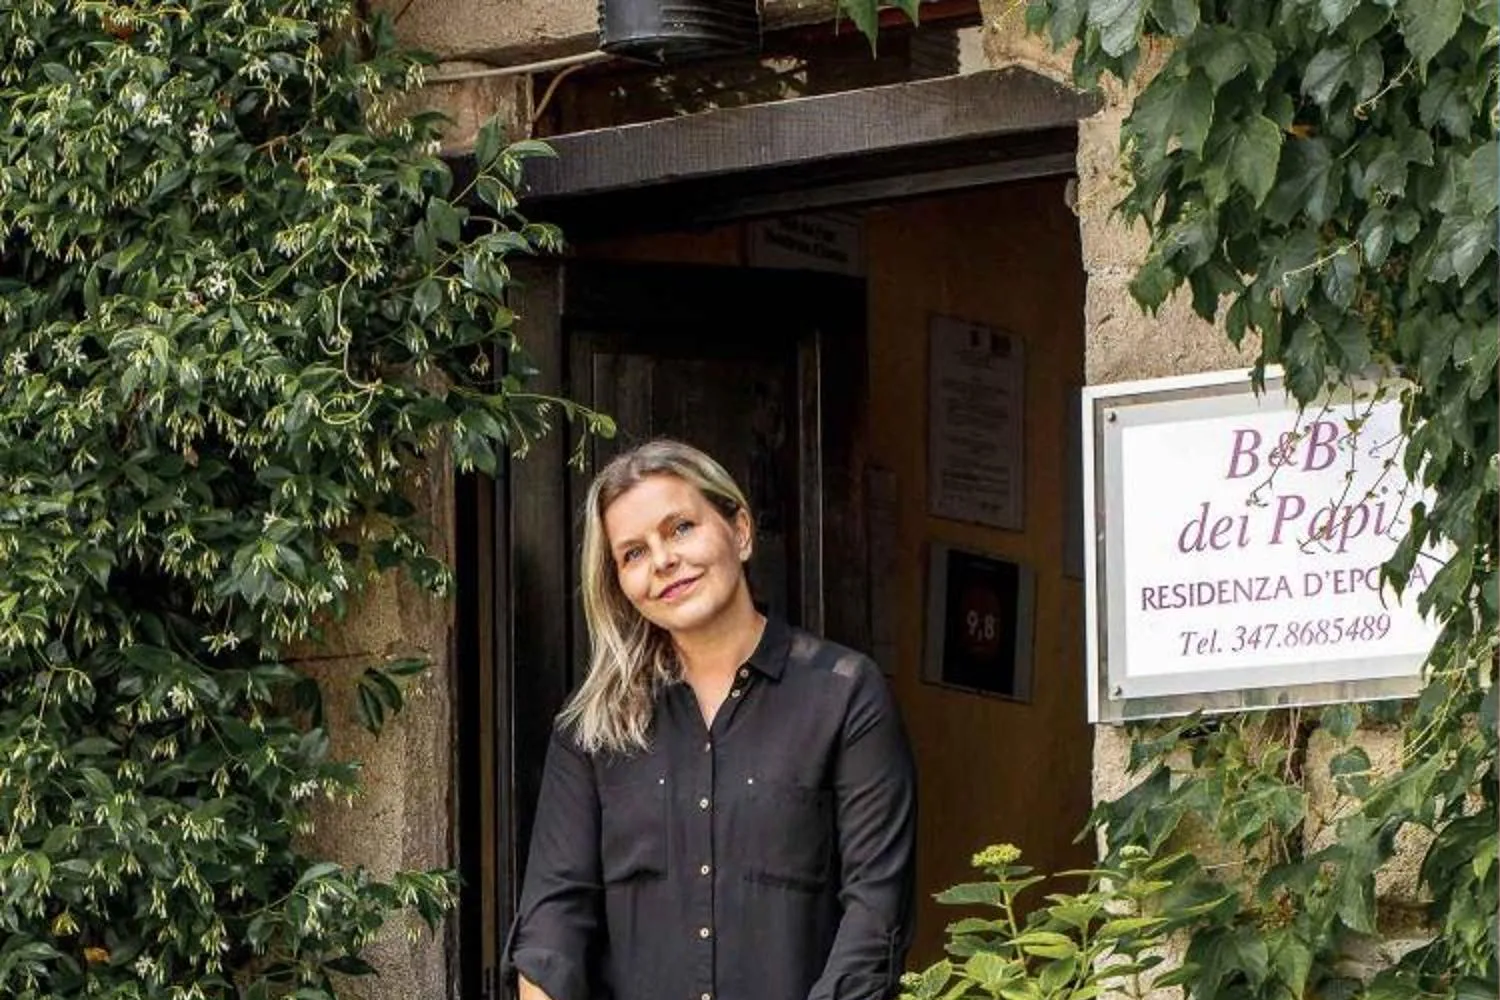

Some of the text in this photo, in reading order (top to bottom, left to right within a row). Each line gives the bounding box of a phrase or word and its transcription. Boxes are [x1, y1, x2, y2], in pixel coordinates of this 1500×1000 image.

[1226, 420, 1341, 481] B&B
[1177, 486, 1389, 555] dei Papi
[1141, 563, 1428, 612] RESIDENZA D'EPOA
[1180, 613, 1392, 656] Tel. 347.8685489
